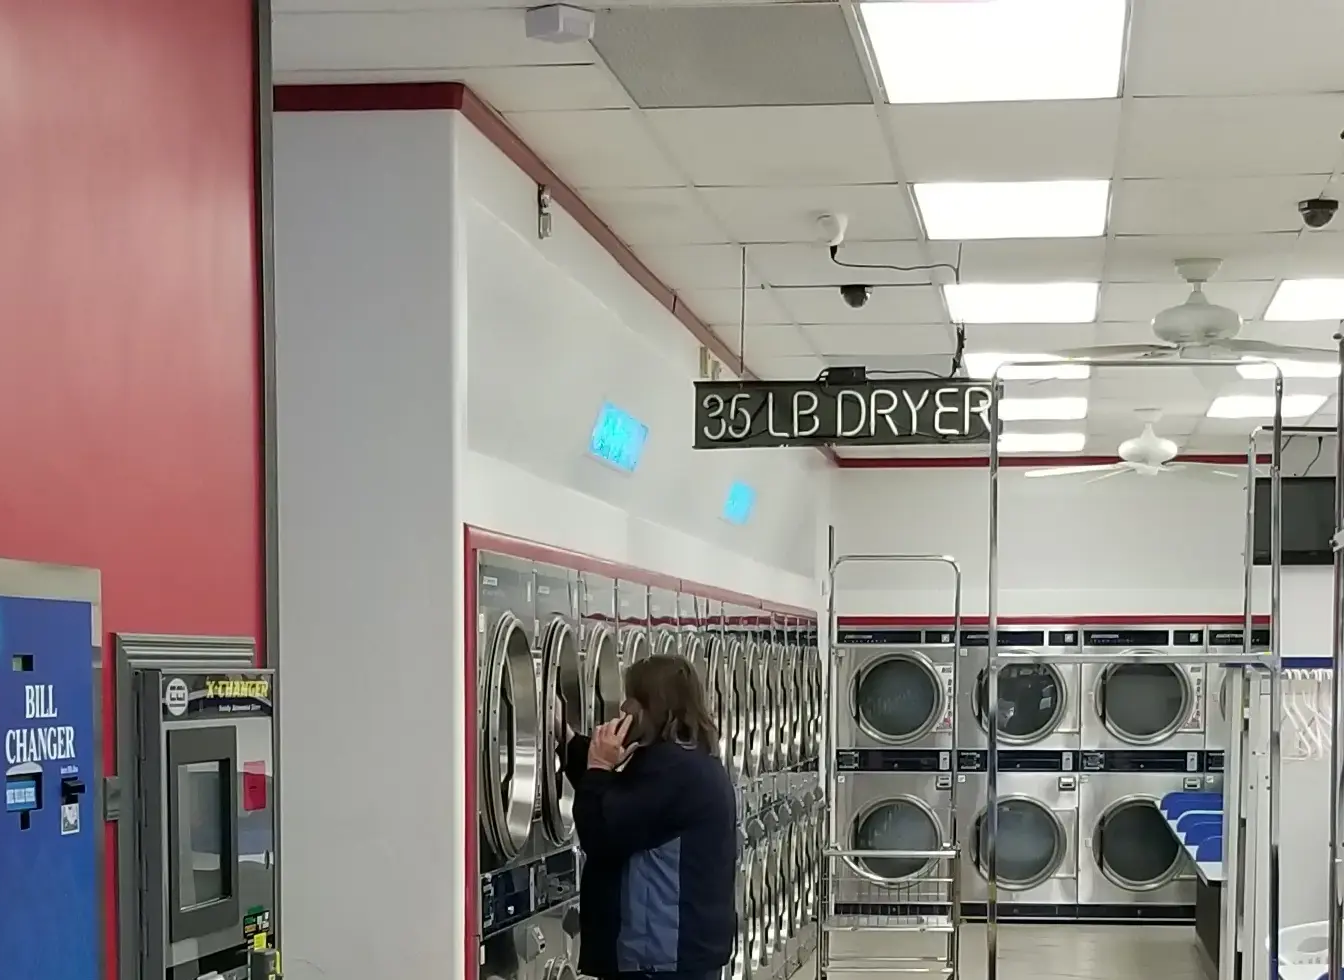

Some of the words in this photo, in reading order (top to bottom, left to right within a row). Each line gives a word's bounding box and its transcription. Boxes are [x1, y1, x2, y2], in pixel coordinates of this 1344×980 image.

[701, 391, 753, 441] 35
[767, 390, 820, 439] LB
[835, 386, 992, 438] DRYER
[24, 684, 58, 719] BILL
[5, 725, 76, 765] CHANGER
